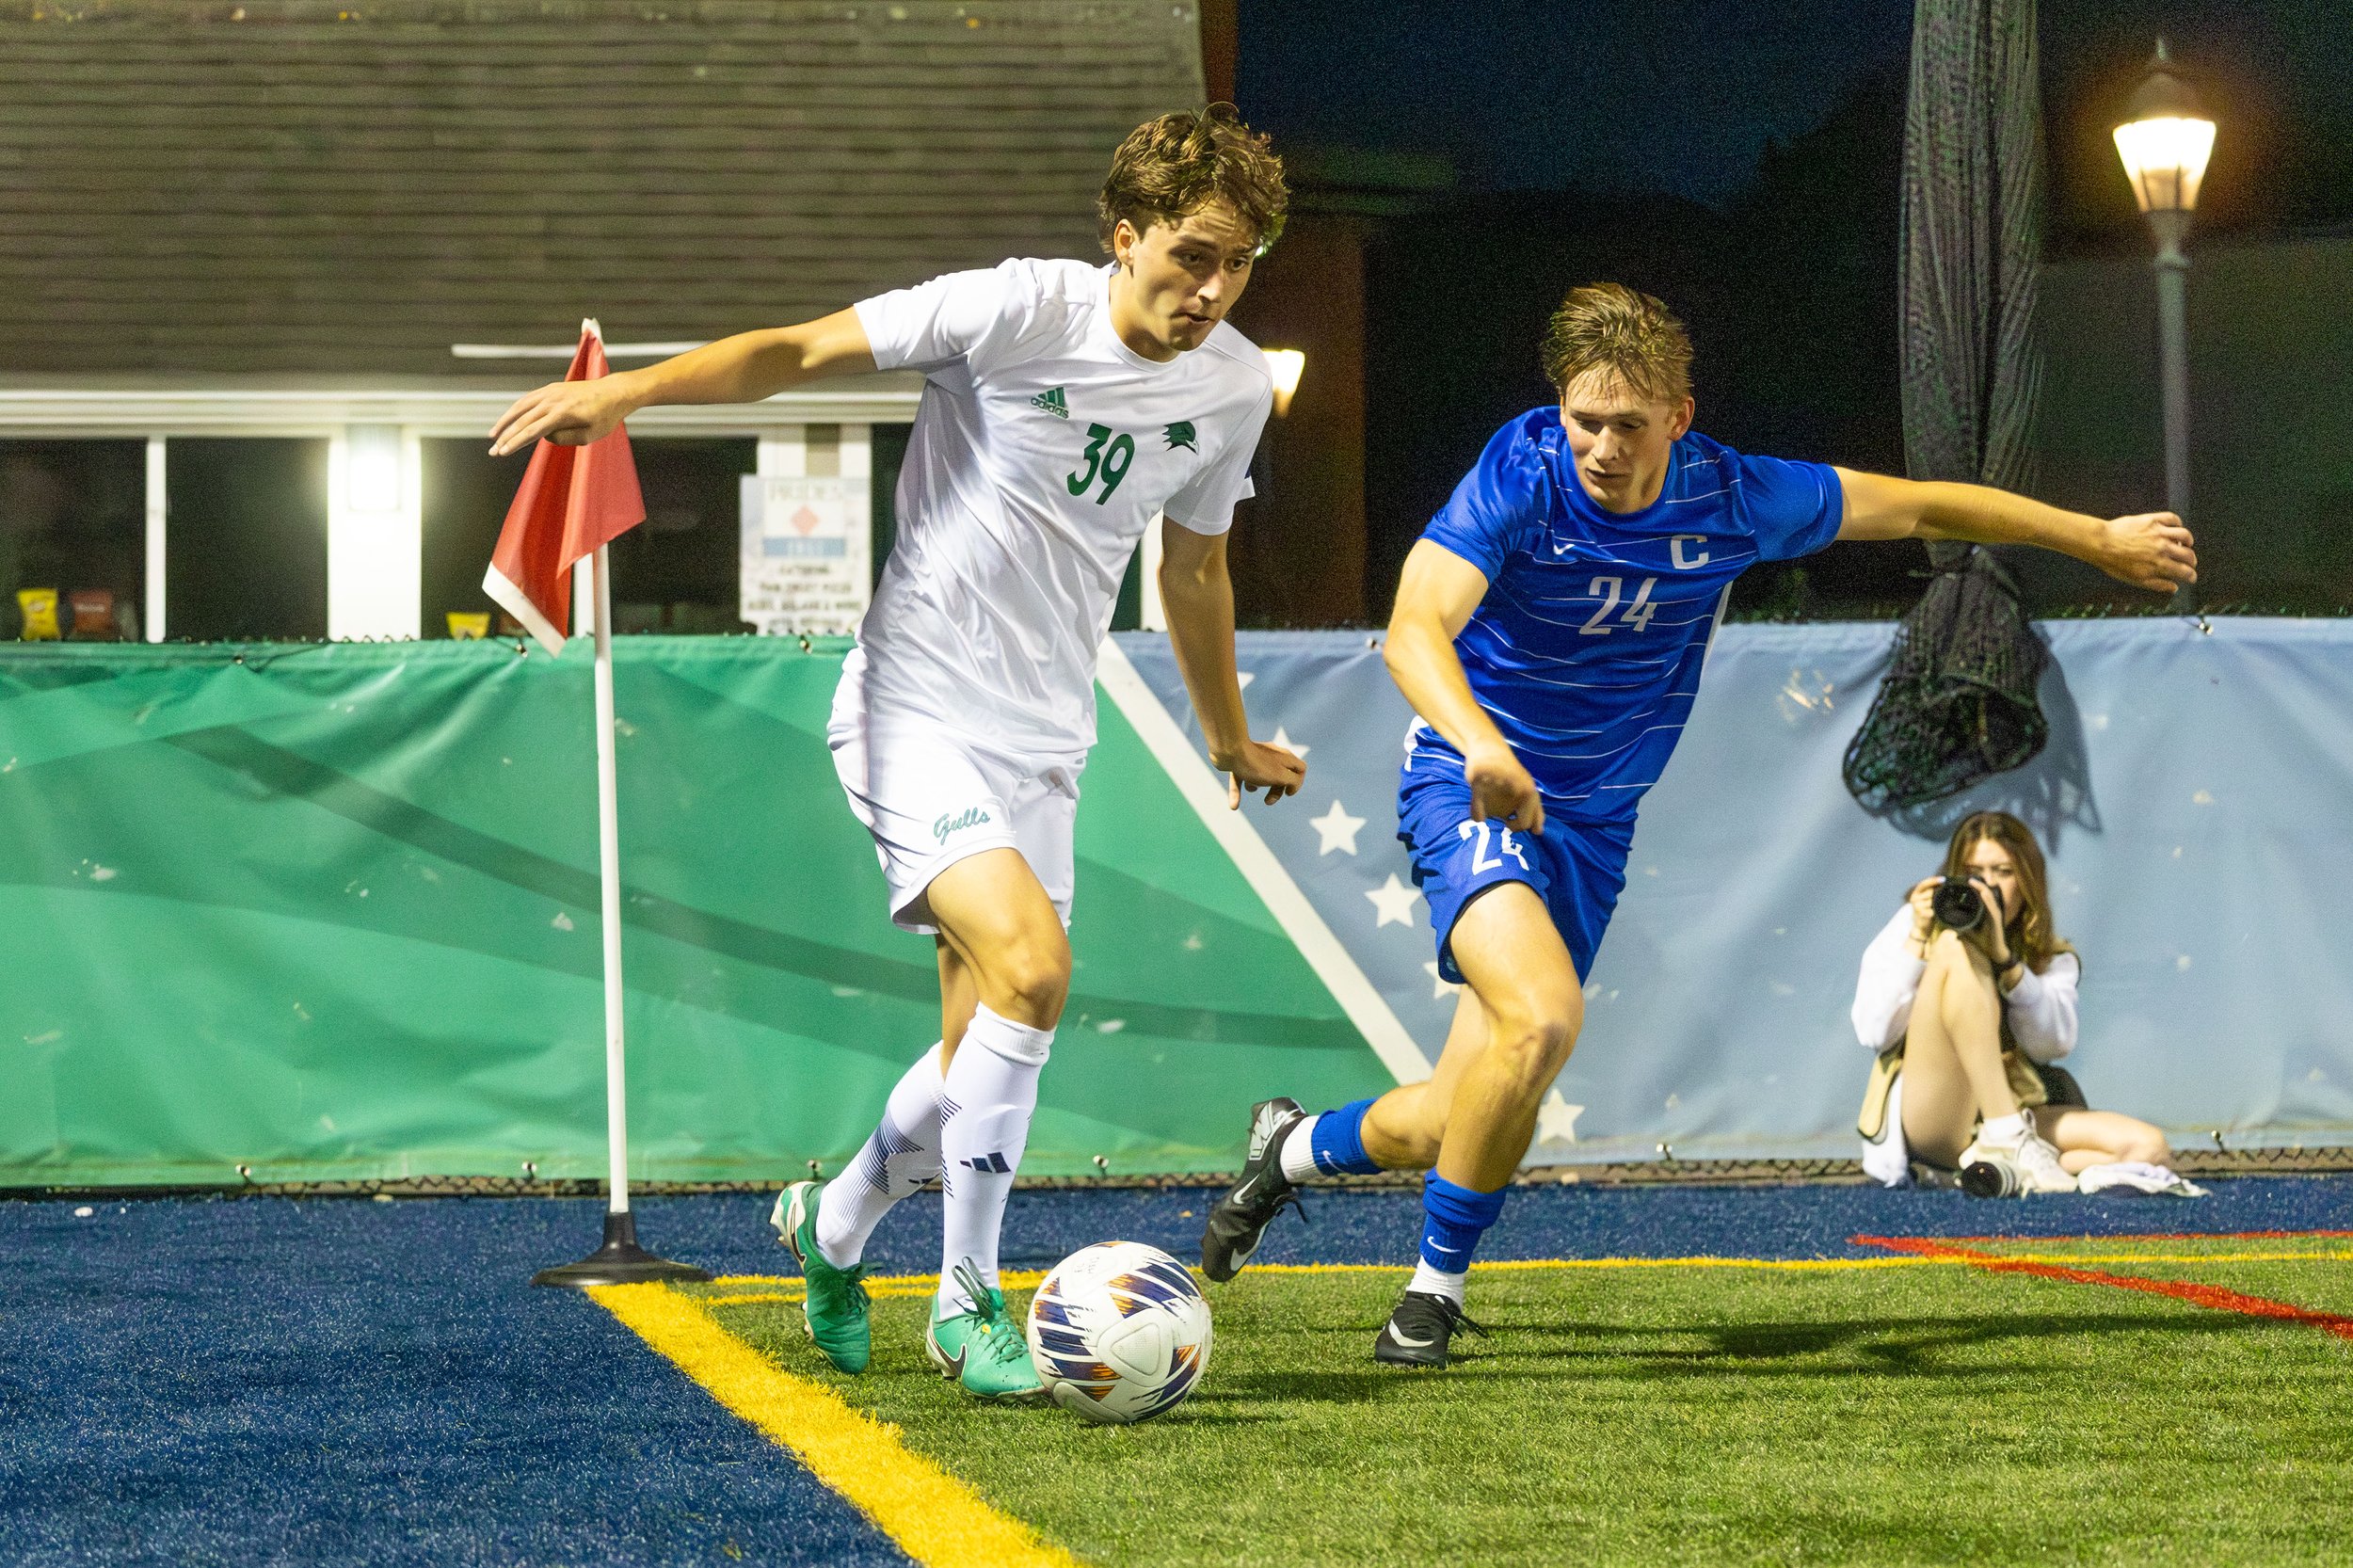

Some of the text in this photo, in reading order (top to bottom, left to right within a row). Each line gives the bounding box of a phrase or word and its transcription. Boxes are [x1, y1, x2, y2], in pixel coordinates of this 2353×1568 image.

[1030, 397, 1069, 420] adidas
[1066, 423, 1135, 506] 39
[1670, 534, 1709, 570] C
[1578, 576, 1657, 635] 24
[933, 807, 991, 846] Gulls
